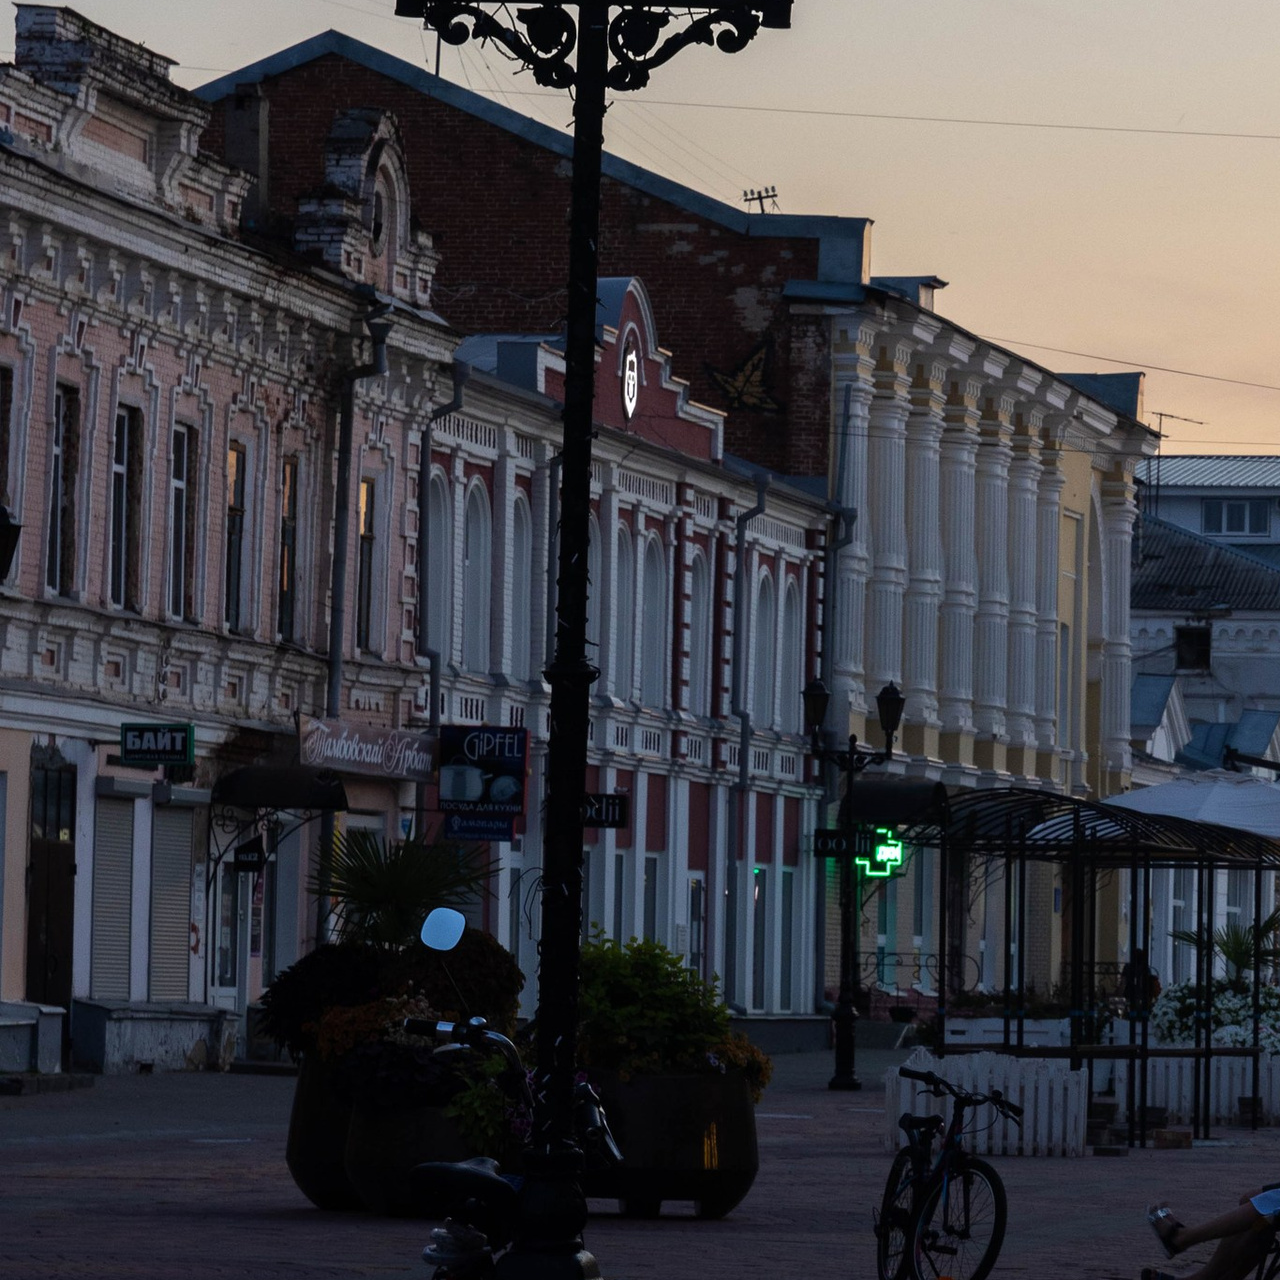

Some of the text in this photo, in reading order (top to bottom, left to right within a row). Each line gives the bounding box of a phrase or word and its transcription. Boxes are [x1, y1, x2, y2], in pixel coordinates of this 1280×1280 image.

[126, 728, 186, 751] БАЙТ
[383, 730, 433, 776] Арбат
[440, 802, 522, 813] ПОСУДА ДЛЯ КУХНИ
